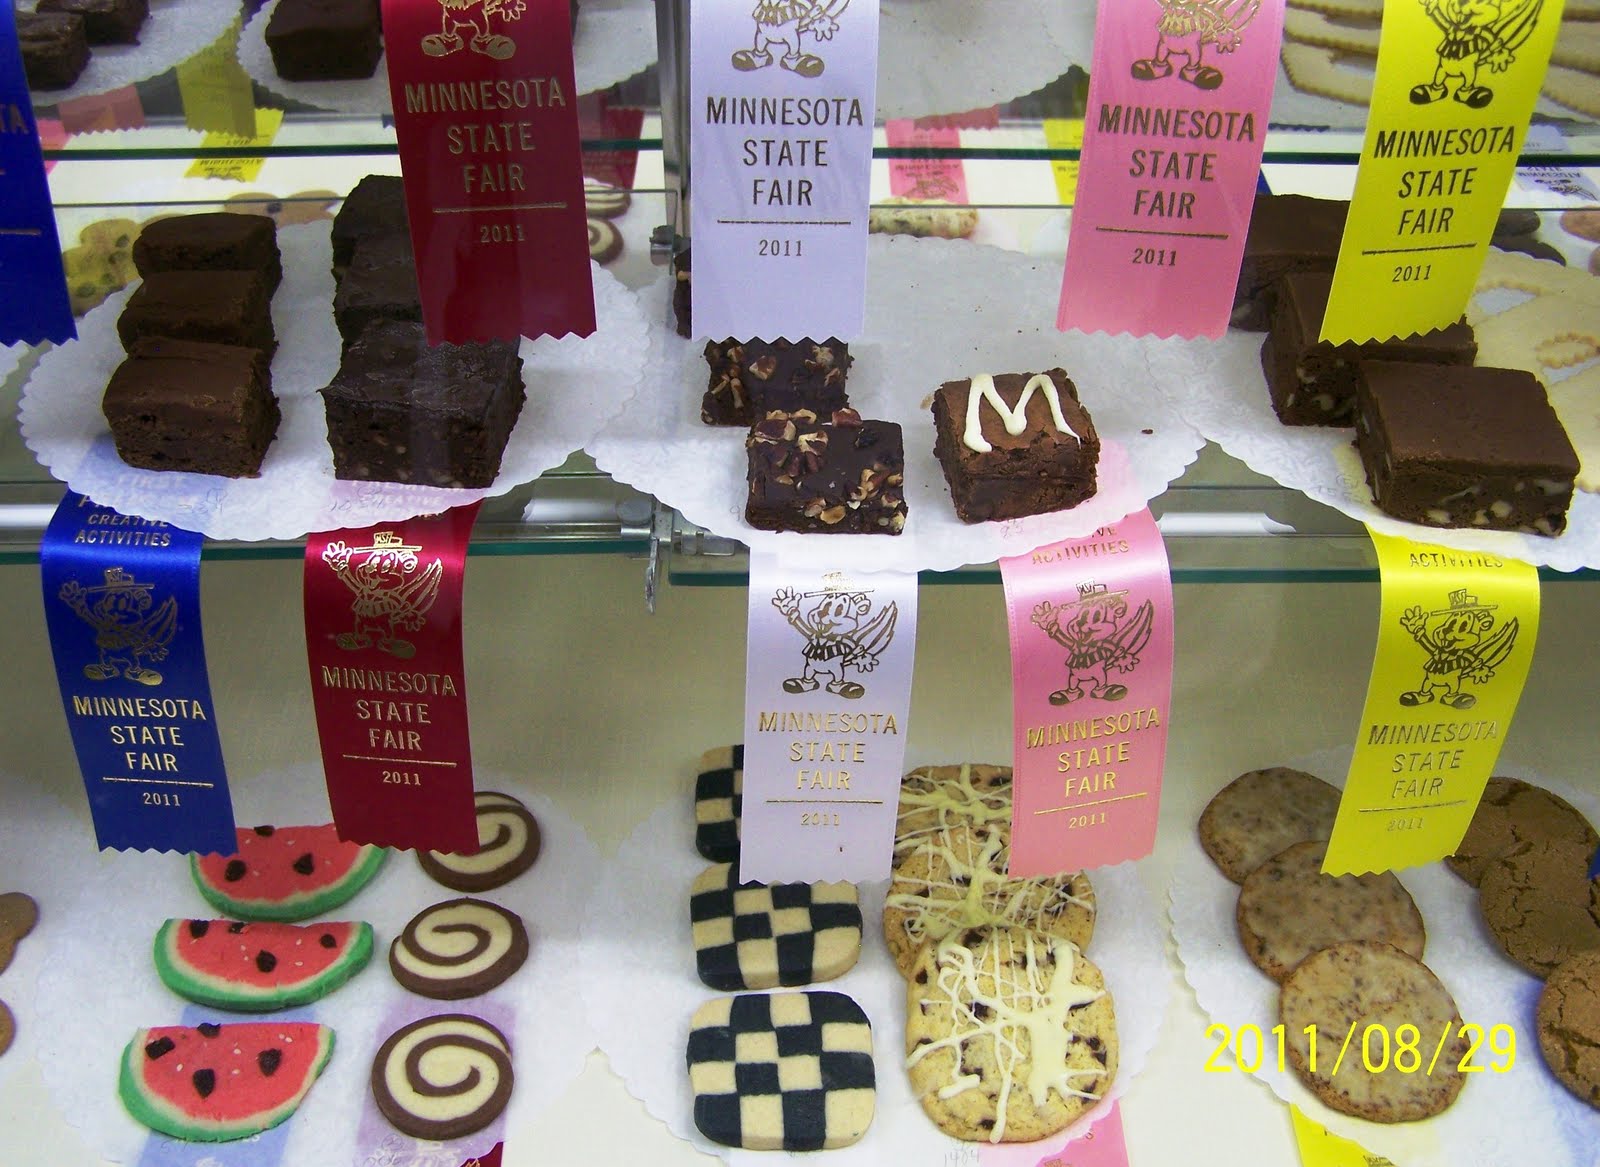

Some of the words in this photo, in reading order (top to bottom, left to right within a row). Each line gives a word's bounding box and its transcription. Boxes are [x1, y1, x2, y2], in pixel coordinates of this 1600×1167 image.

[405, 77, 566, 113] MINNESOTA
[706, 97, 863, 127] MINNESOTA
[1098, 104, 1255, 142] MINNESOTA
[448, 123, 535, 155] STATE
[1374, 126, 1514, 159] MINNESOTA
[743, 139, 828, 167] STATE
[463, 164, 525, 192] FAIR
[1130, 150, 1217, 182] STATE
[752, 179, 813, 206] FAIR
[1398, 169, 1475, 199] STATE
[1134, 190, 1195, 219] FAIR
[480, 225, 525, 242] 2011
[1398, 207, 1454, 236] FAIR
[759, 240, 803, 256] 2011
[1133, 247, 1177, 266] 2011
[1391, 264, 1430, 282] 2011
[75, 529, 171, 547] ACTIVITIES
[322, 665, 457, 697] MINNESOTA
[73, 696, 206, 721] MINNESOTA
[356, 701, 431, 724] STATE
[758, 711, 897, 735] MINNESOTA
[1026, 708, 1160, 749] MINNESOTA
[1368, 721, 1497, 745] MINNESOTA
[110, 725, 184, 746] STATE
[369, 730, 422, 751] FAIR
[127, 752, 177, 772] FAIR
[791, 742, 866, 763] STATE
[1057, 744, 1129, 772] STATE
[1392, 750, 1464, 773] STATE
[382, 770, 421, 786] 2011
[798, 770, 851, 790] FAIR
[1065, 771, 1116, 797] FAIR
[1393, 778, 1444, 799] FAIR
[143, 792, 180, 807] 2011
[801, 812, 841, 826] 2011
[1069, 814, 1106, 829] 2011
[1387, 817, 1424, 832] 2011
